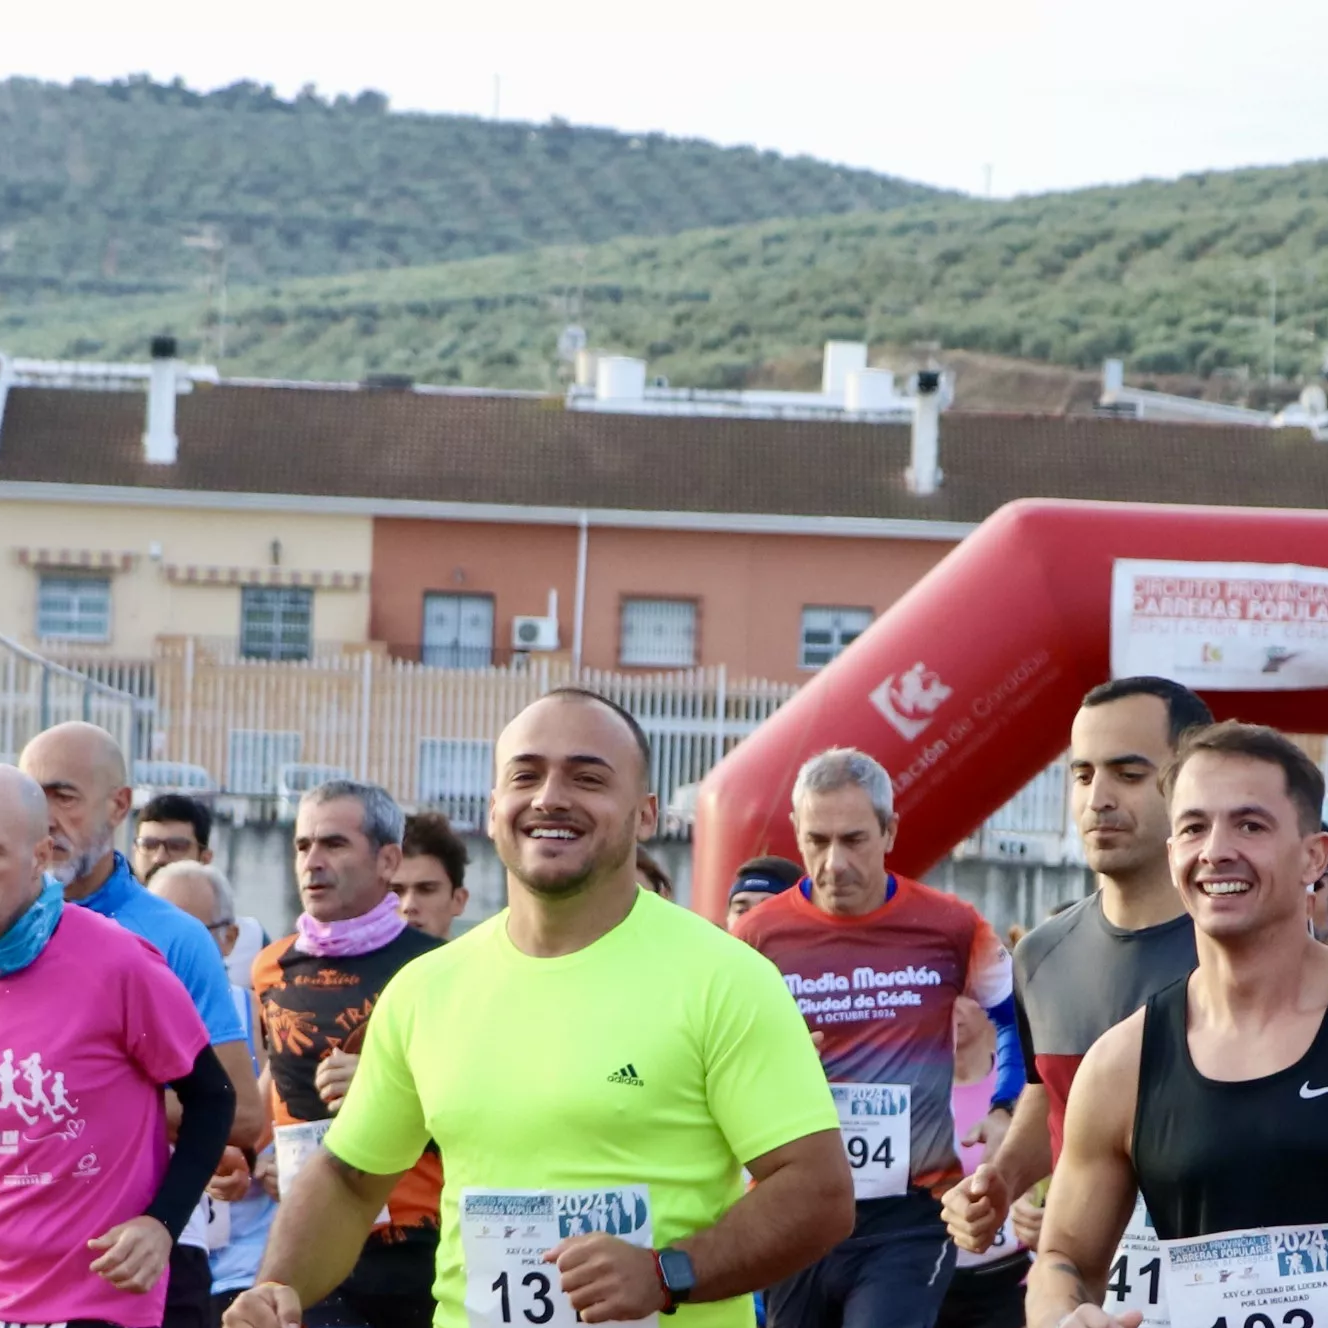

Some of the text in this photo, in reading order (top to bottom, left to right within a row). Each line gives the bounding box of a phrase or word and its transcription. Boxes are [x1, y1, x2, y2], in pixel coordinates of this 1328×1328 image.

[1133, 578, 1221, 600] CIRCUITO
[1133, 597, 1242, 618] CARRERAS
[784, 965, 941, 996] Media Maratón
[798, 990, 921, 1014] Ciudad de Cádiz
[825, 1009, 870, 1022] OCTUBRE
[872, 1008, 897, 1019] 2024
[607, 1074, 645, 1087] adidas
[555, 1193, 607, 1217] 2024
[1209, 1237, 1260, 1251] PROVINCIAL
[1273, 1229, 1326, 1253] 2024
[1171, 1244, 1273, 1264] CARRERAS POPULARES
[1222, 1290, 1239, 1299] XXV
[1256, 1286, 1285, 1296] CIUDAD
[1285, 1284, 1297, 1293] DE
[1297, 1281, 1328, 1292] LUCENA
[1240, 1294, 1310, 1308] POR LA IGUALDAD
